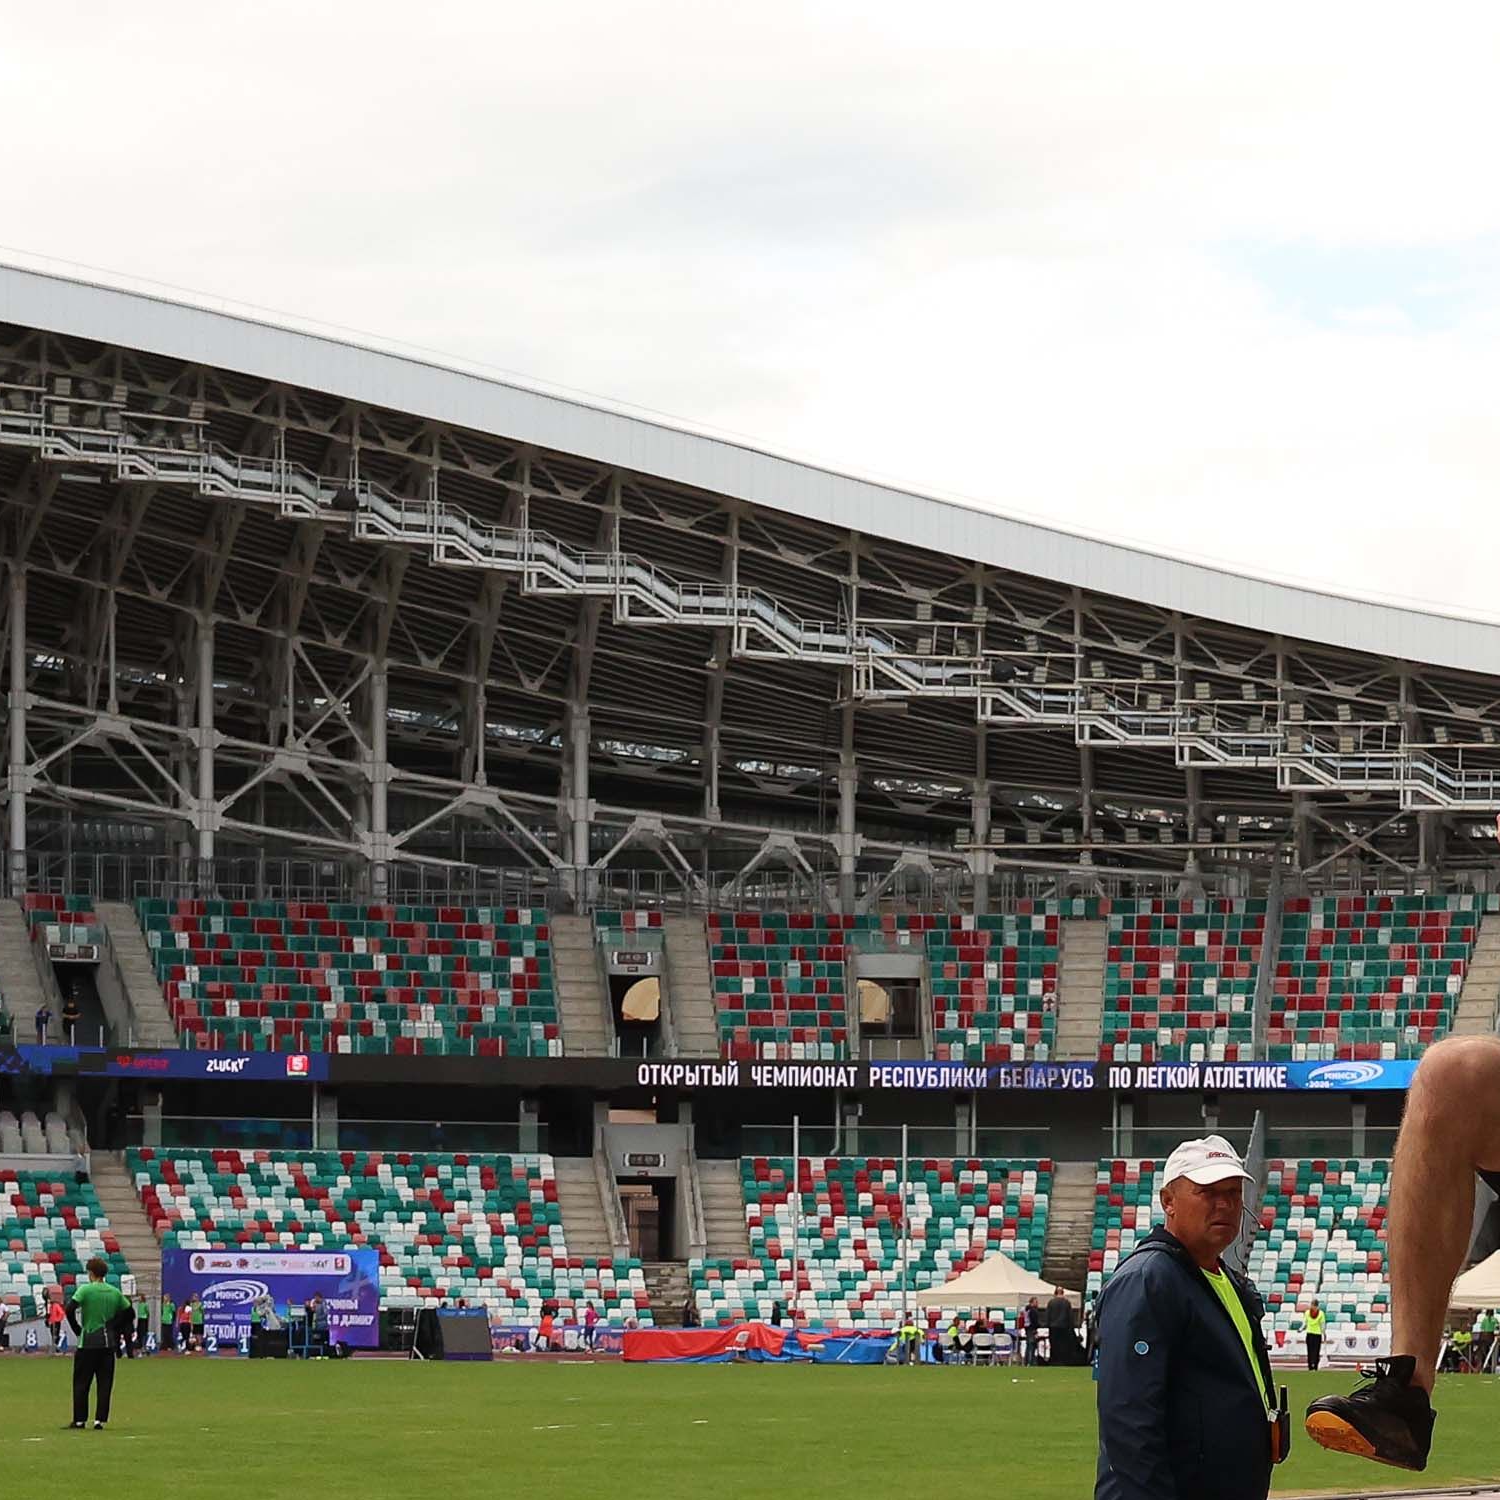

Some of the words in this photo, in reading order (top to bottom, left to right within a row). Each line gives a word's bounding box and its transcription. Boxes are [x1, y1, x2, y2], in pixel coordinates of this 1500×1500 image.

[291, 1056, 303, 1071] 5
[638, 1061, 739, 1086] ОТКРЫТЫЙ
[751, 1066, 858, 1088] ЧЕМПИОНАТ
[869, 1066, 988, 1088] РЕСПУБЛИКИ
[1000, 1066, 1094, 1088] БЕЛАРУСЬ
[1109, 1067, 1132, 1088] ПО
[1134, 1063, 1200, 1088] ЛЕГКОЙ
[1204, 1066, 1288, 1088] АТЛЕТИКЕ
[216, 1291, 246, 1300] МИНСК
[27, 1332, 36, 1346] 8
[146, 1334, 156, 1350] 4
[207, 1338, 218, 1352] 2
[240, 1338, 248, 1352] 1
